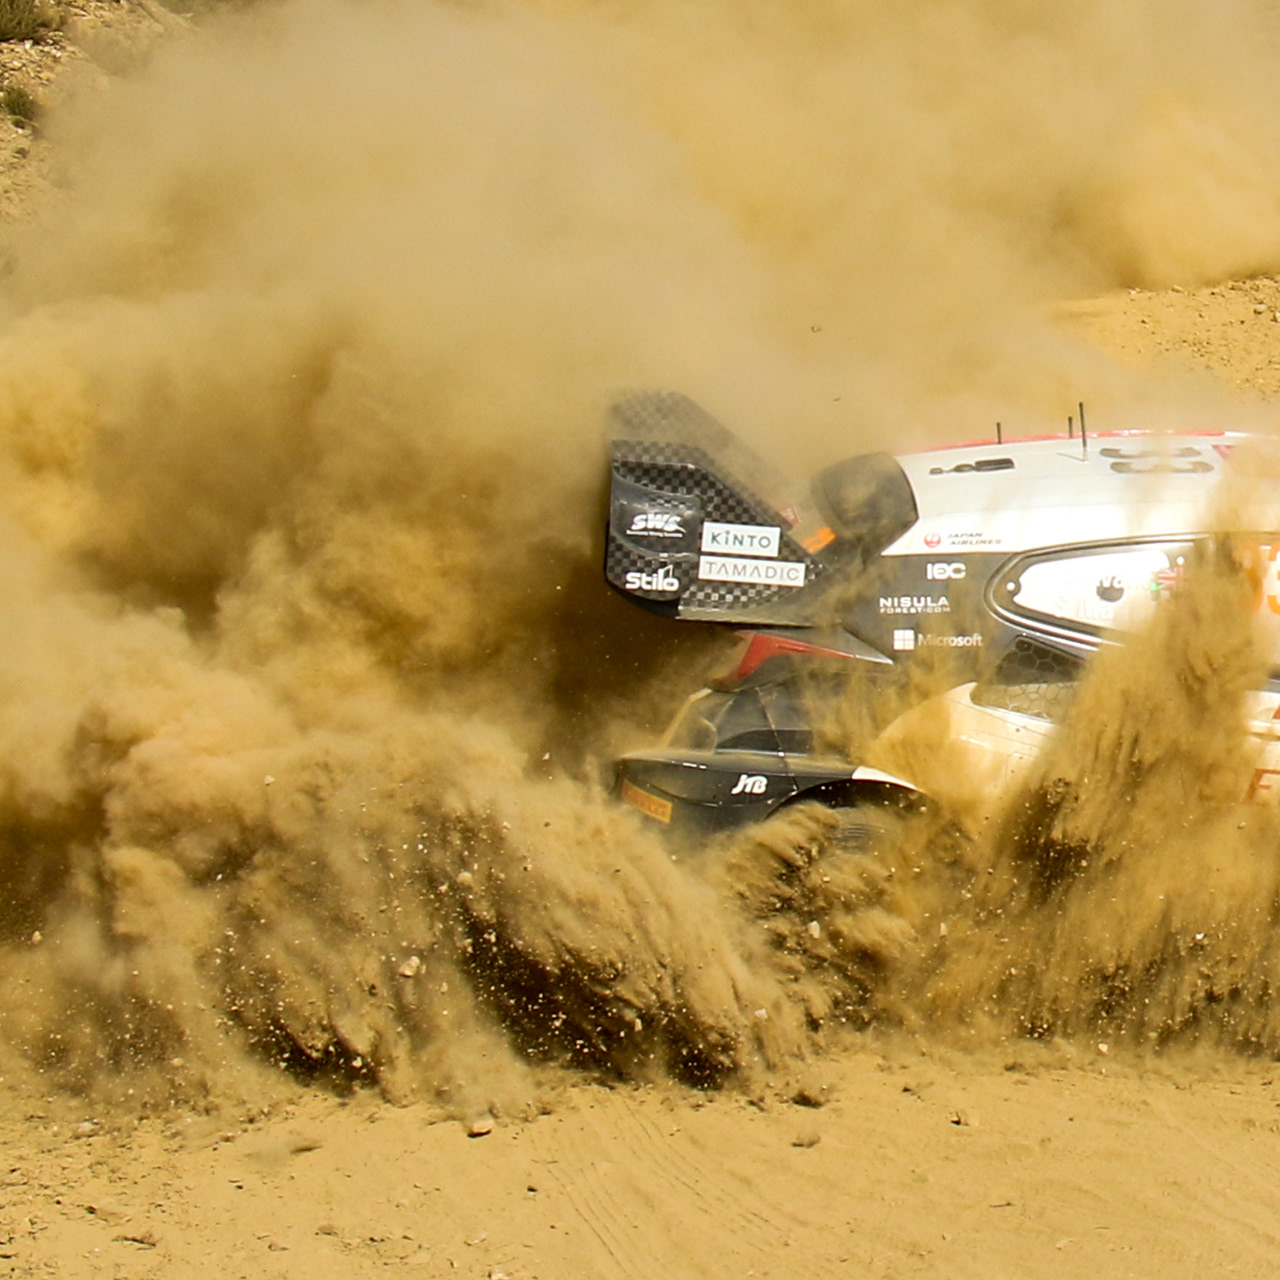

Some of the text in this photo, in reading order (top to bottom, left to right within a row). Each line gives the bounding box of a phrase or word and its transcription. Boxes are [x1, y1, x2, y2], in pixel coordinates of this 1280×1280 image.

[711, 530, 771, 549] KINTO
[625, 564, 680, 591] Stilo
[706, 561, 800, 581] TAMADIC
[879, 596, 950, 608] NISULA
[917, 633, 983, 648] Microsoft
[730, 774, 768, 795] JTB
